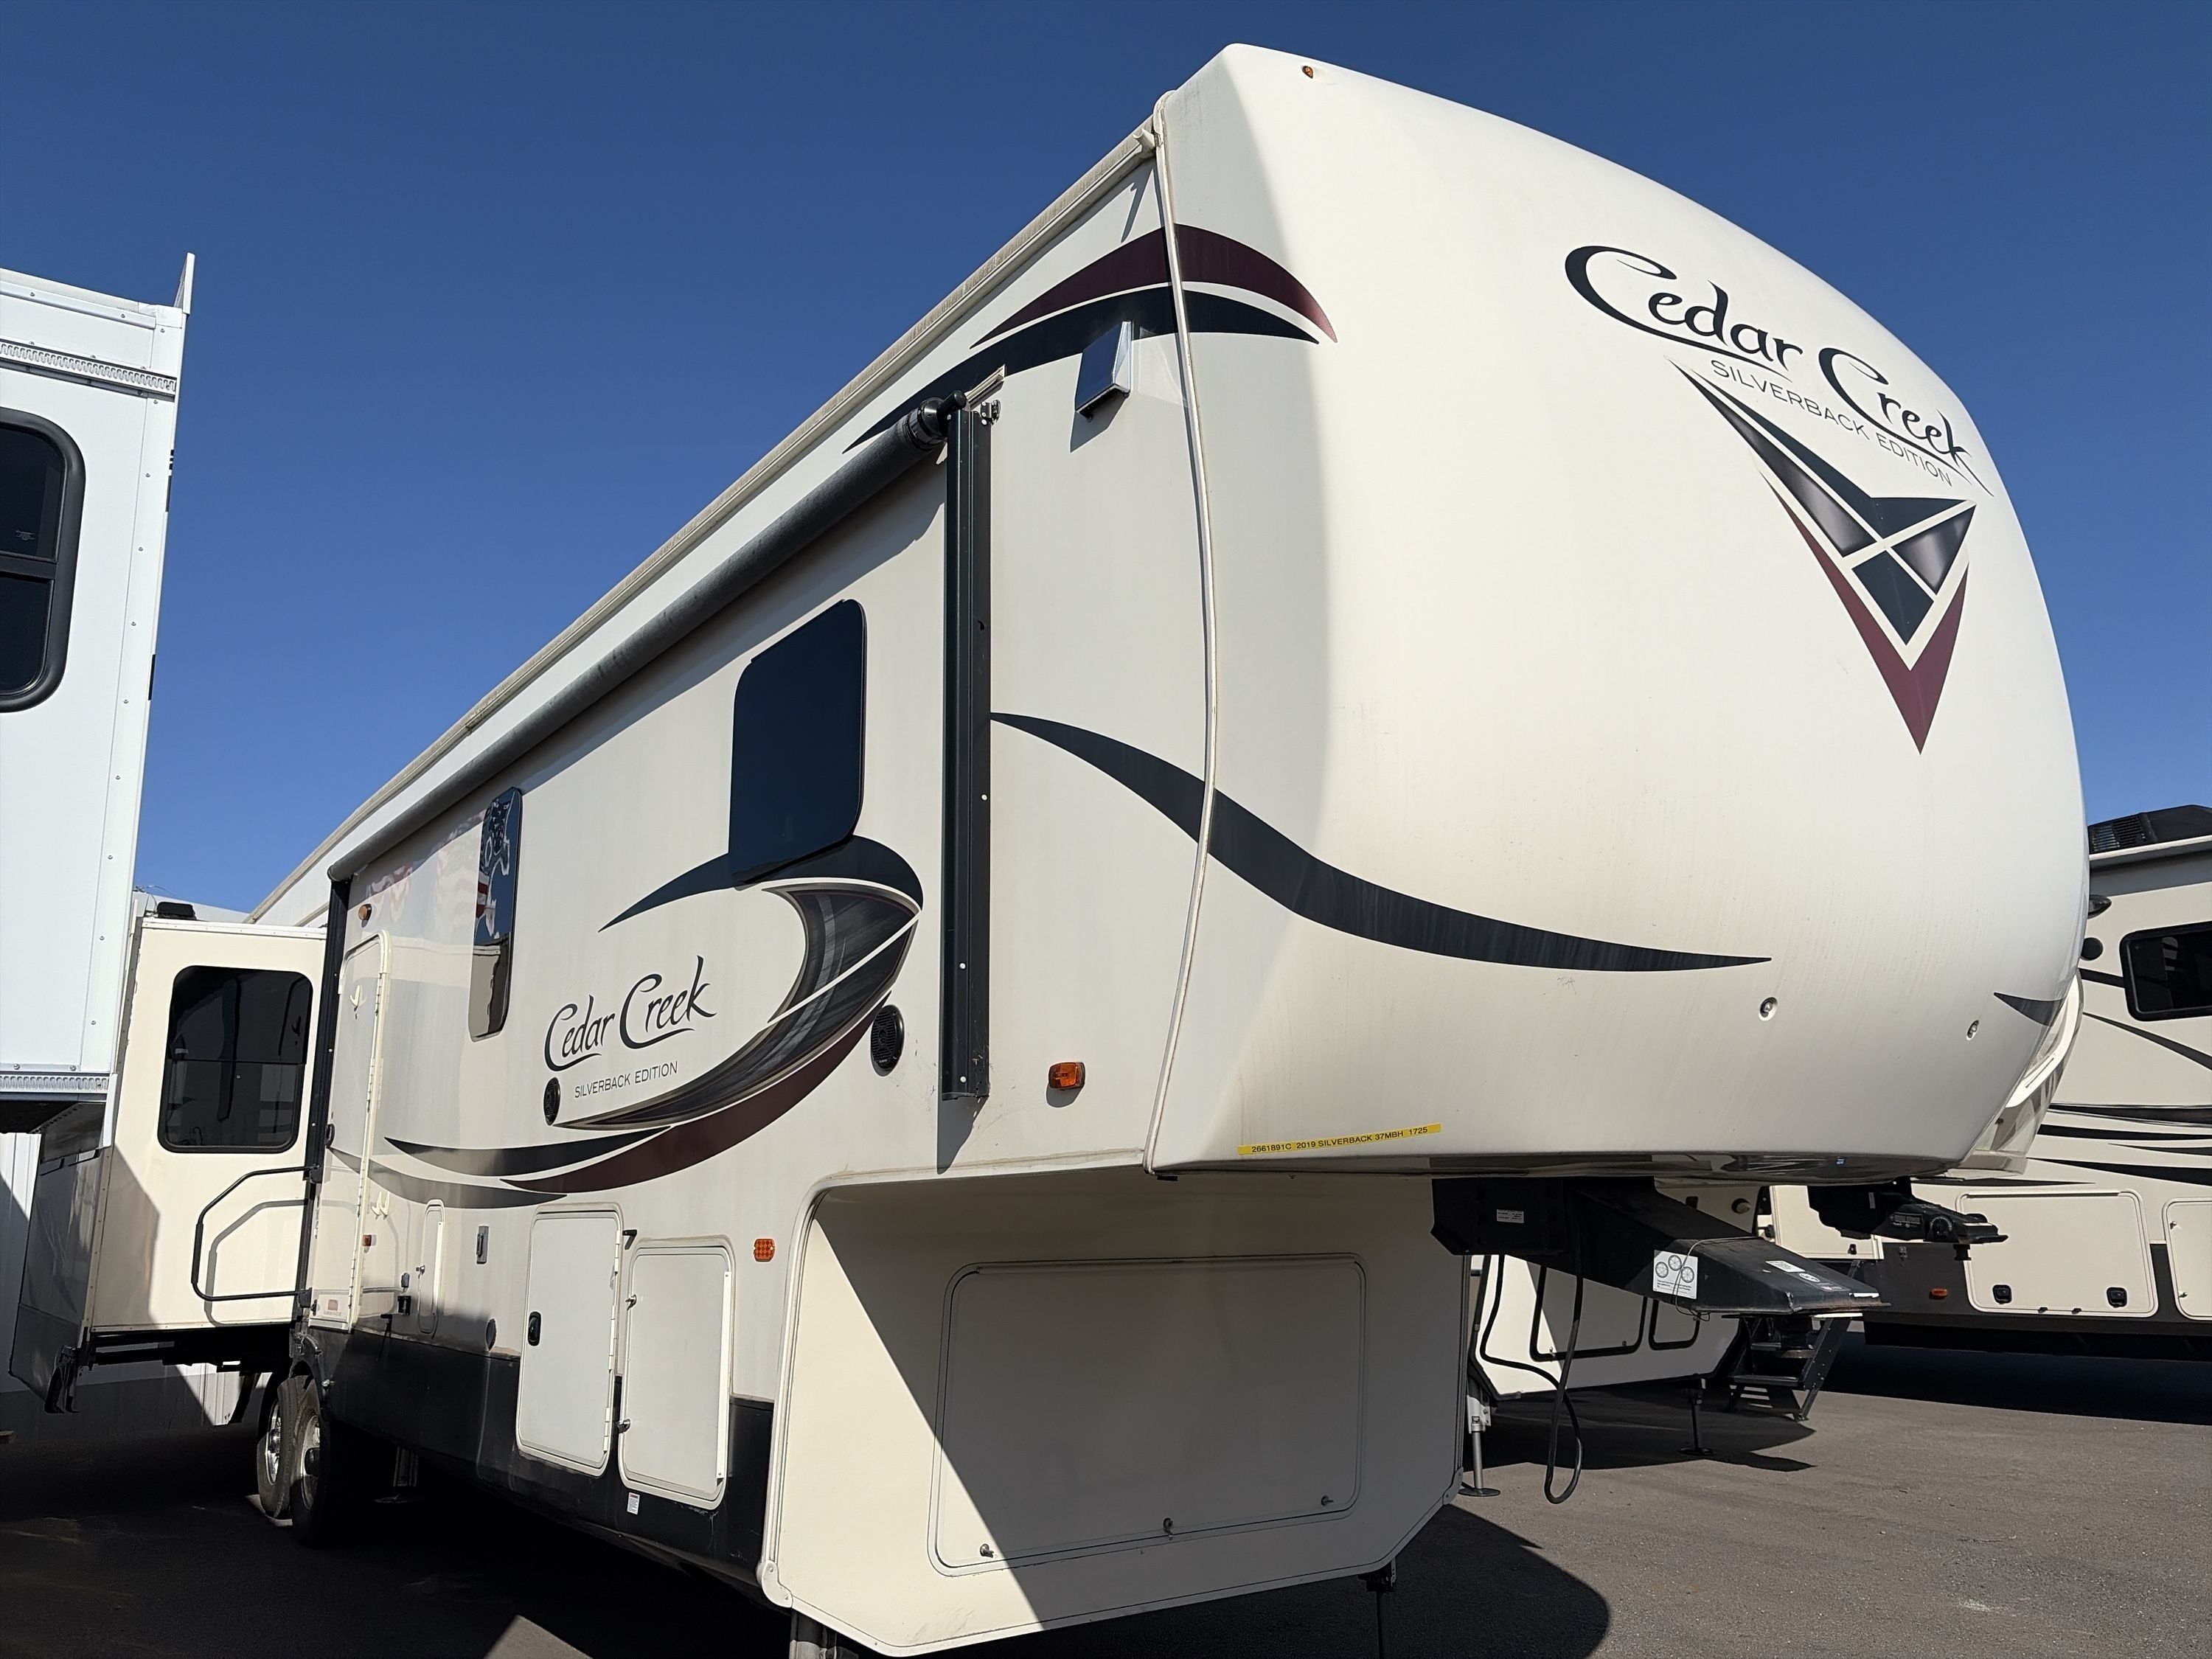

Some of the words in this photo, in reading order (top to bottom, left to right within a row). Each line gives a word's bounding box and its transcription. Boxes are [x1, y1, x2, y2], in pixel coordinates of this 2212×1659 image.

[1565, 246, 1803, 382] Cedar
[1818, 347, 1994, 497] Creek
[1711, 360, 1871, 441] SILVERBACK
[1876, 432, 1953, 487] EDITION
[544, 994, 616, 1071] Cedar
[619, 955, 717, 1050] Creek
[574, 1074, 631, 1099] SILVERBACK
[635, 1060, 678, 1084] EDITION
[1251, 1143, 1292, 1152] 2661891C
[1296, 1141, 1316, 1149] 2019
[1318, 1134, 1372, 1147] SILVERBACK
[1375, 1130, 1404, 1141] 37MBH
[1409, 1127, 1428, 1135] 1725
